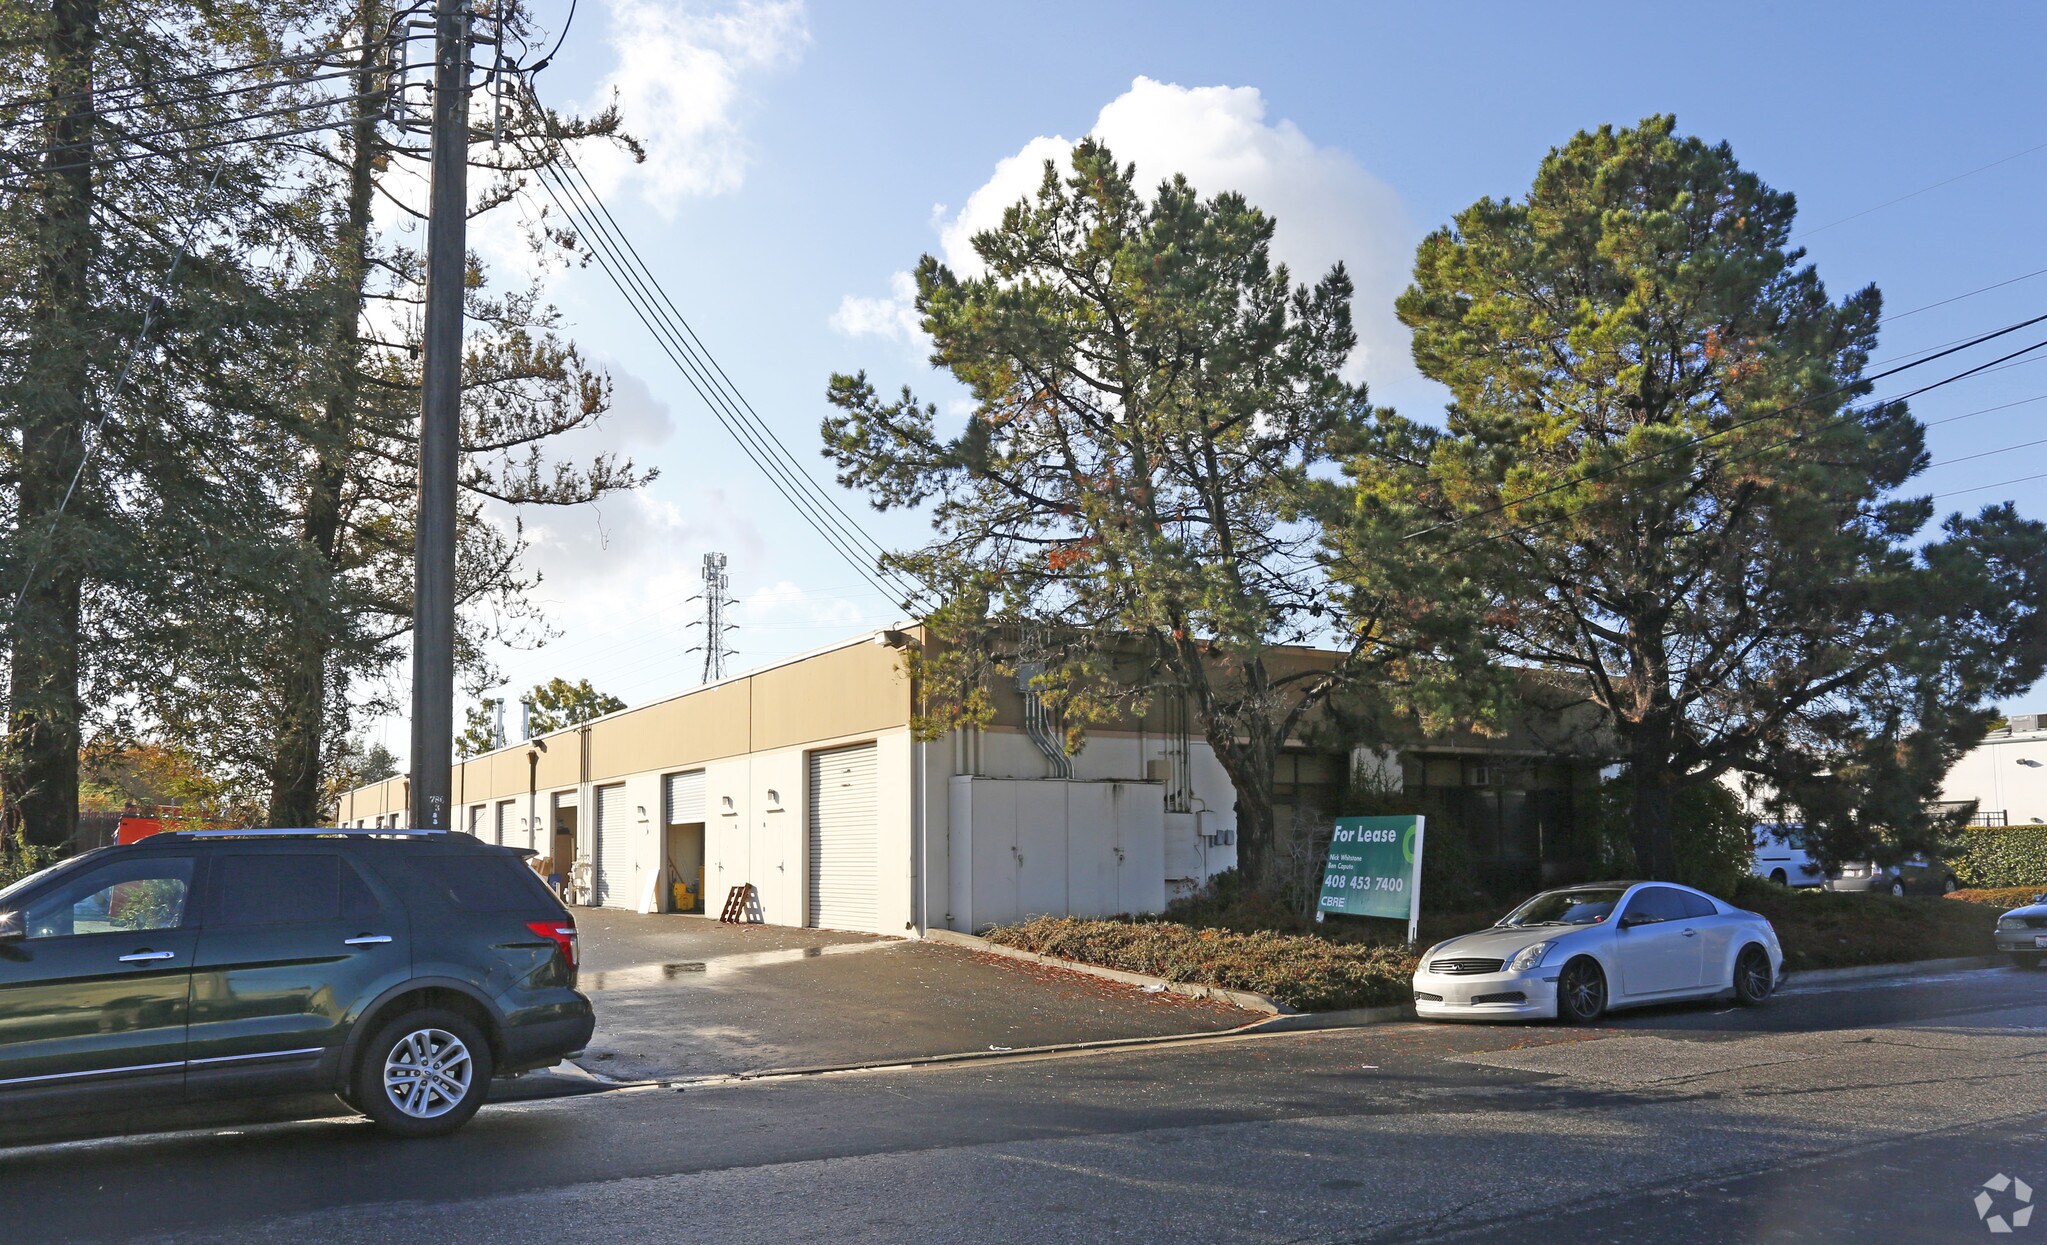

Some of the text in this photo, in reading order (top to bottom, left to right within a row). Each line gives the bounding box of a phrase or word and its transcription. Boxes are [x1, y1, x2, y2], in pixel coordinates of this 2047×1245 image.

[1333, 825, 1397, 842] For Lease
[1324, 874, 1403, 892] 408 453 7400
[1321, 896, 1346, 908] CBRE
